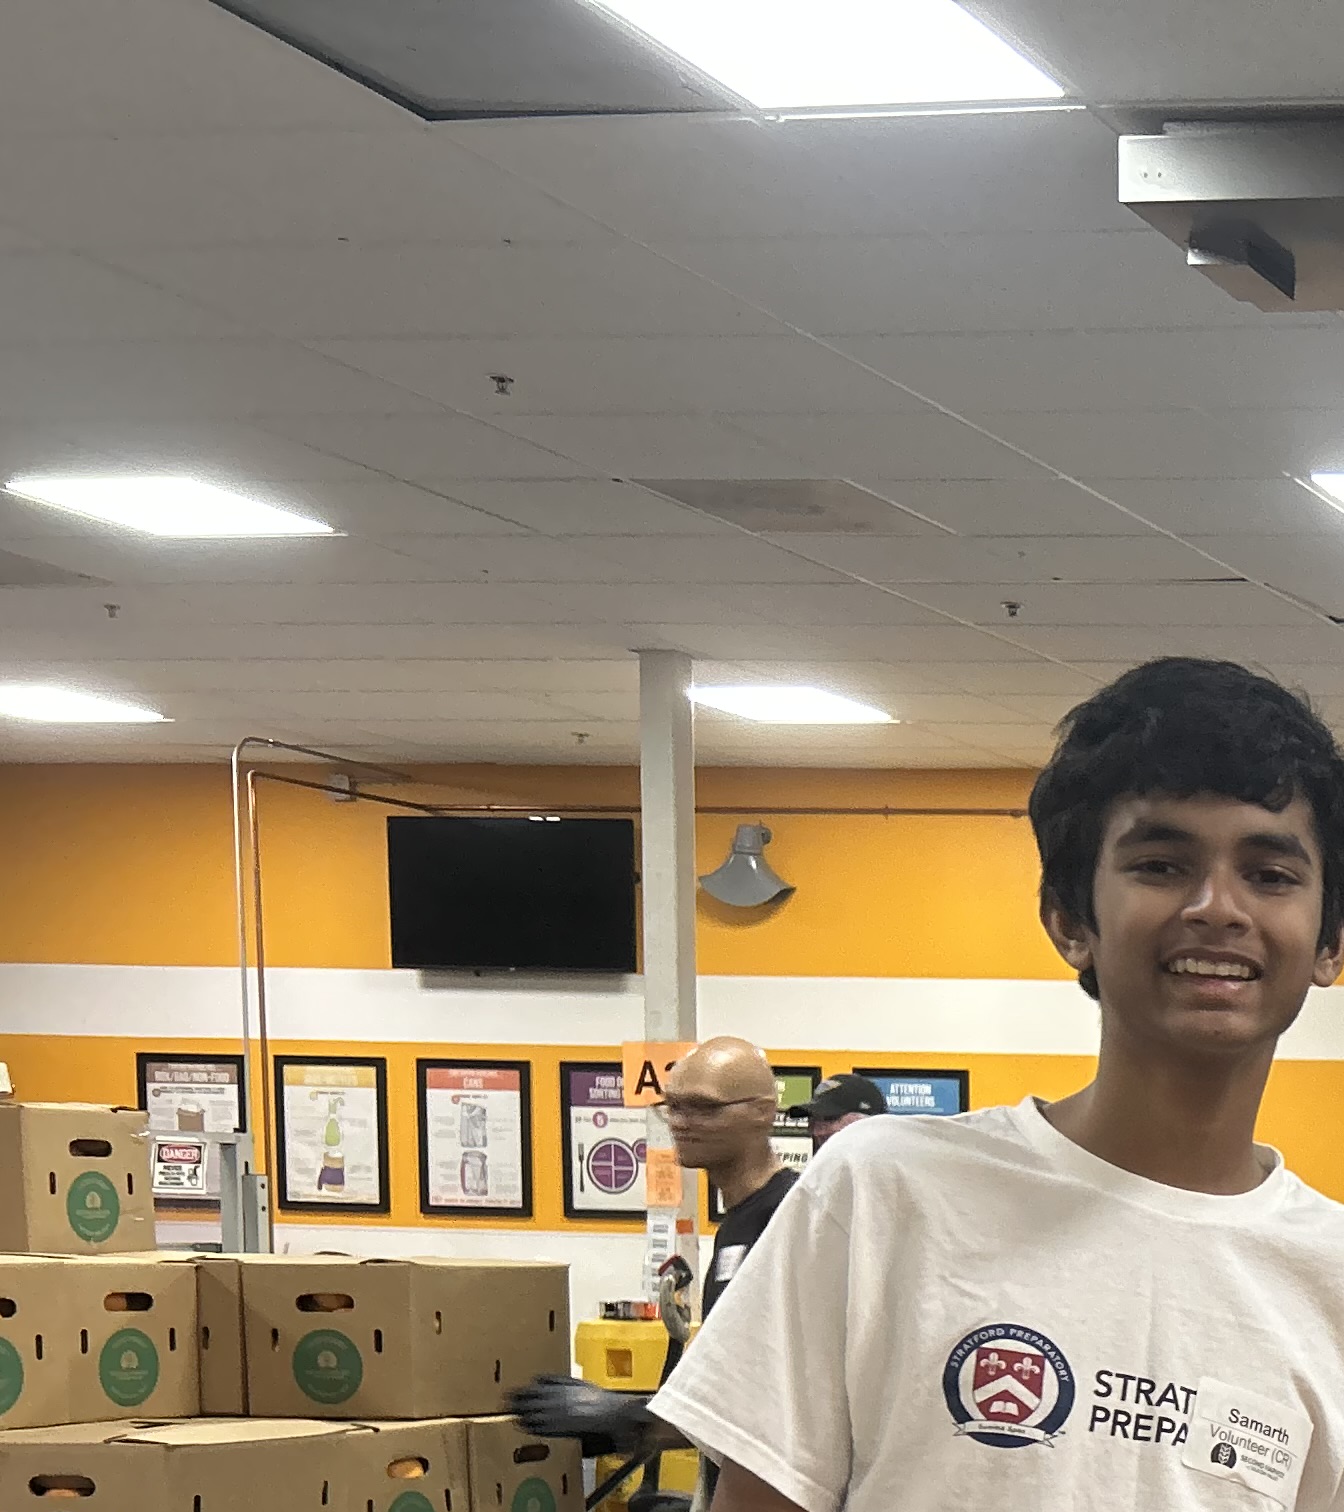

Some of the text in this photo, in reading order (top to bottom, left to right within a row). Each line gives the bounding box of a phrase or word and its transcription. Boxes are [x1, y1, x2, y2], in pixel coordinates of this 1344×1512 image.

[635, 1060, 677, 1095] A
[889, 1083, 932, 1096] ATTENTION
[886, 1096, 936, 1108] VOLUNTEERS
[161, 1148, 200, 1160] DANGER
[950, 1328, 1070, 1382] STRATFORD PREPARATORY
[1093, 1369, 1198, 1415] STRAT
[1228, 1408, 1290, 1446] Samarth
[1210, 1424, 1293, 1471] Volunteer (CR)
